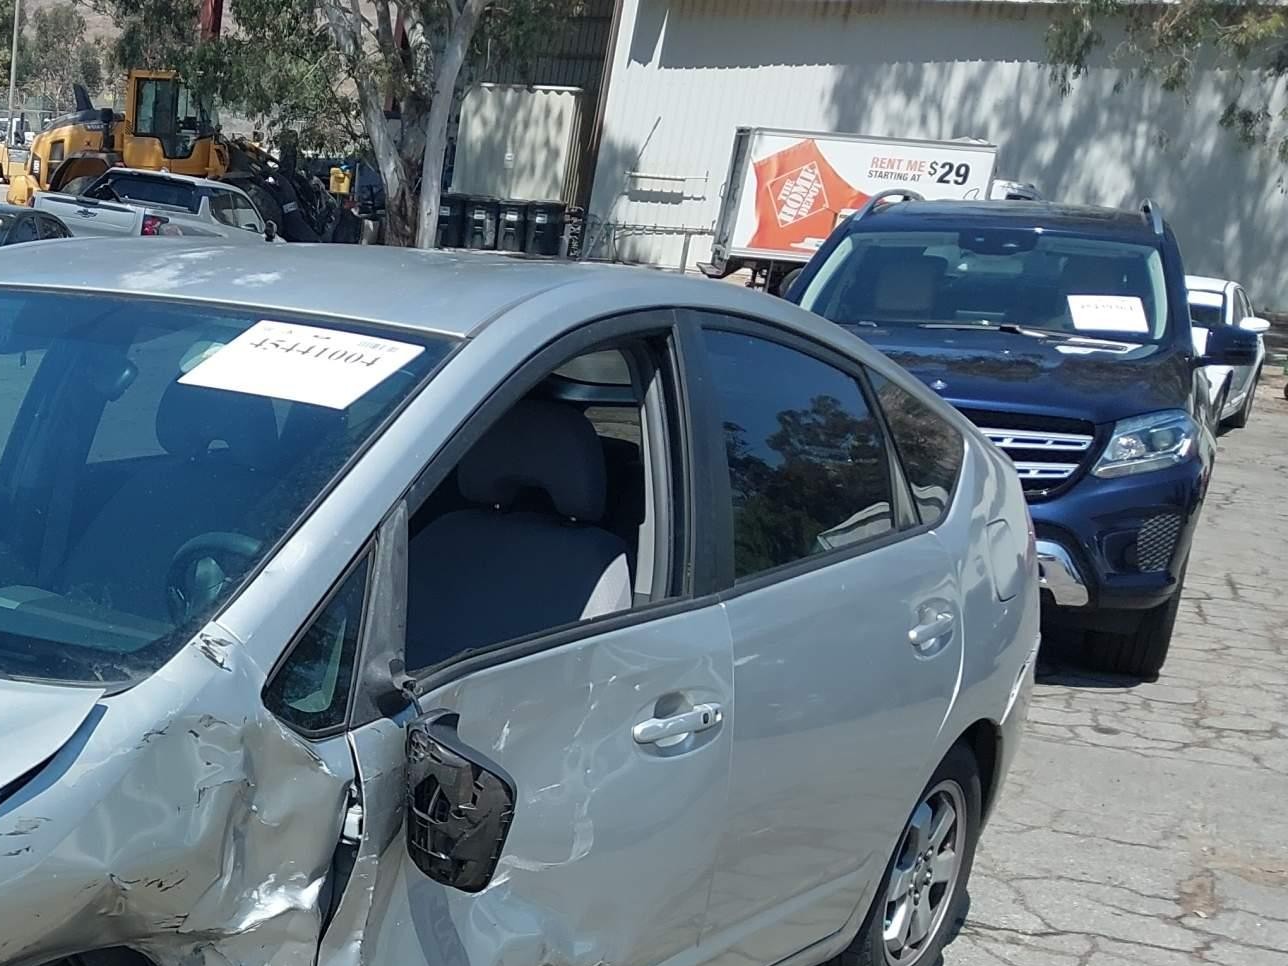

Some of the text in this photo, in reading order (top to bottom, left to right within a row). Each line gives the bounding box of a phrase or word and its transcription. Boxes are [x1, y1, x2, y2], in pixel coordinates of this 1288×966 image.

[867, 170, 921, 182] STARTING AT
[871, 156, 926, 173] RENT ME
[928, 160, 970, 186] $29
[777, 178, 795, 201] THE
[778, 164, 817, 222] HOME
[797, 179, 822, 217] DEPOT
